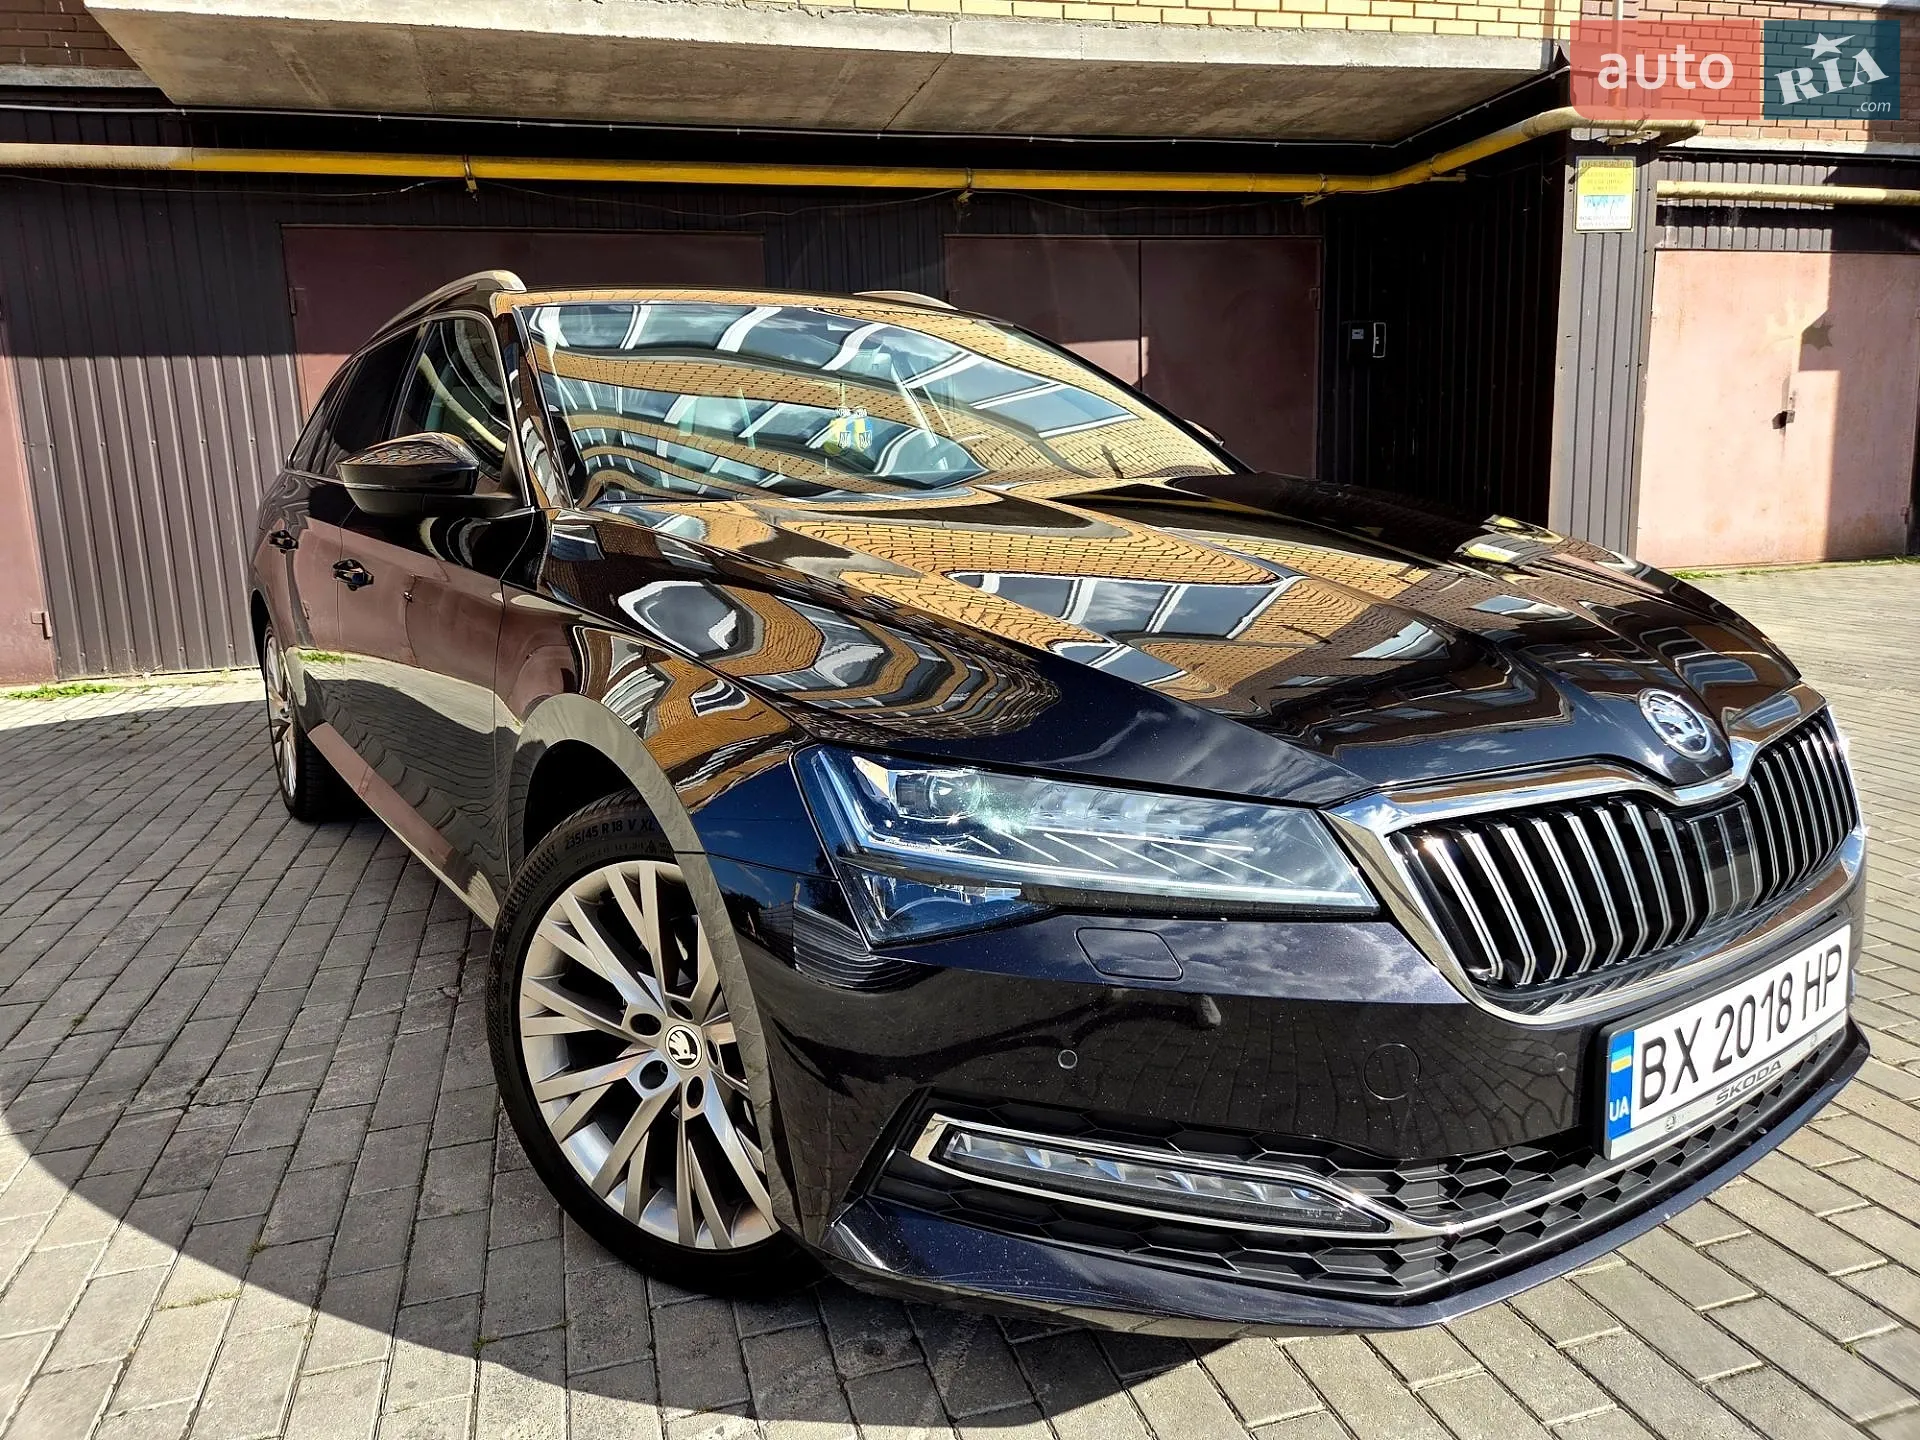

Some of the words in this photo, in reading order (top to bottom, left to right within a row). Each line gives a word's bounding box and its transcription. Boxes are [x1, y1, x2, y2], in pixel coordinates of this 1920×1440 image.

[627, 818, 638, 830] V
[639, 817, 656, 832] XL
[1639, 1016, 1702, 1110] BX
[1713, 971, 1793, 1074] 2018
[1802, 943, 1842, 1021] HP
[1715, 1058, 1785, 1105] ŠKODA
[1609, 1099, 1630, 1122] UA
